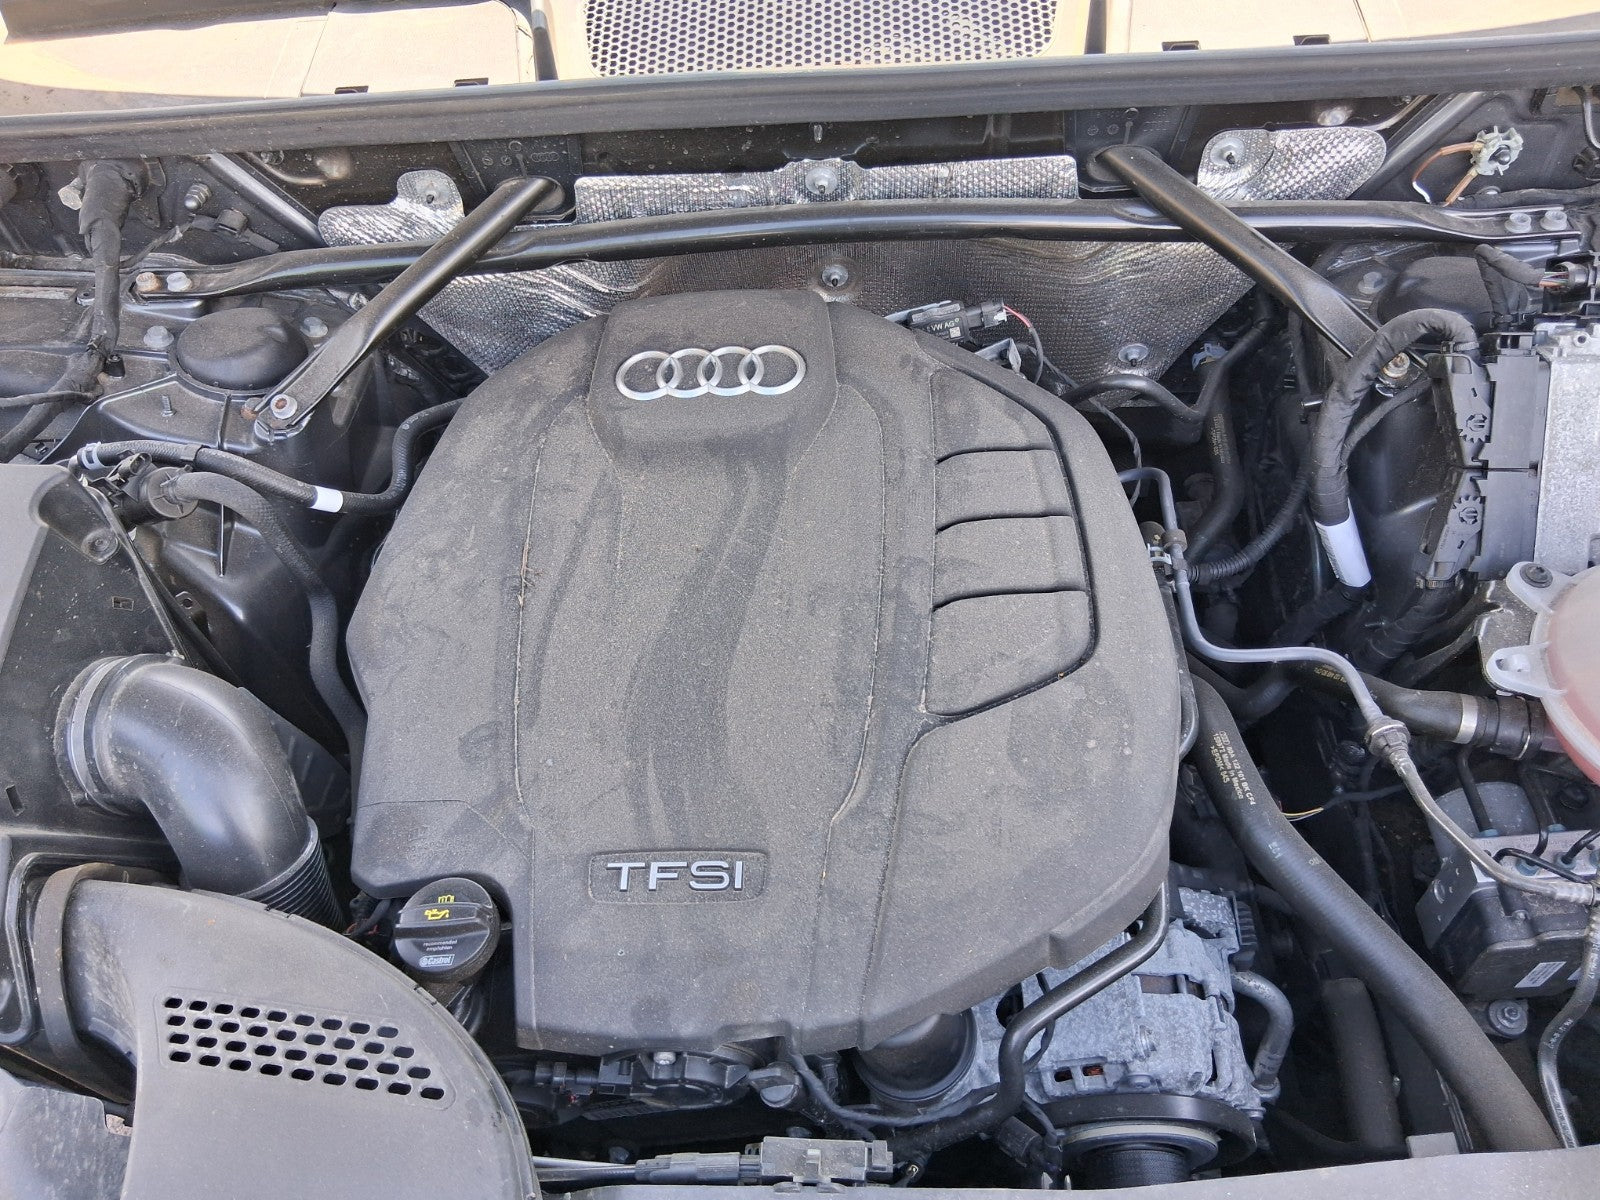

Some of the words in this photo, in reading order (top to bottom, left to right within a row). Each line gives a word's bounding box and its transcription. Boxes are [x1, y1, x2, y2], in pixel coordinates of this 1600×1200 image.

[1231, 777, 1244, 799] Mexico
[606, 860, 743, 891] TFSI
[428, 956, 452, 965] Castrol
